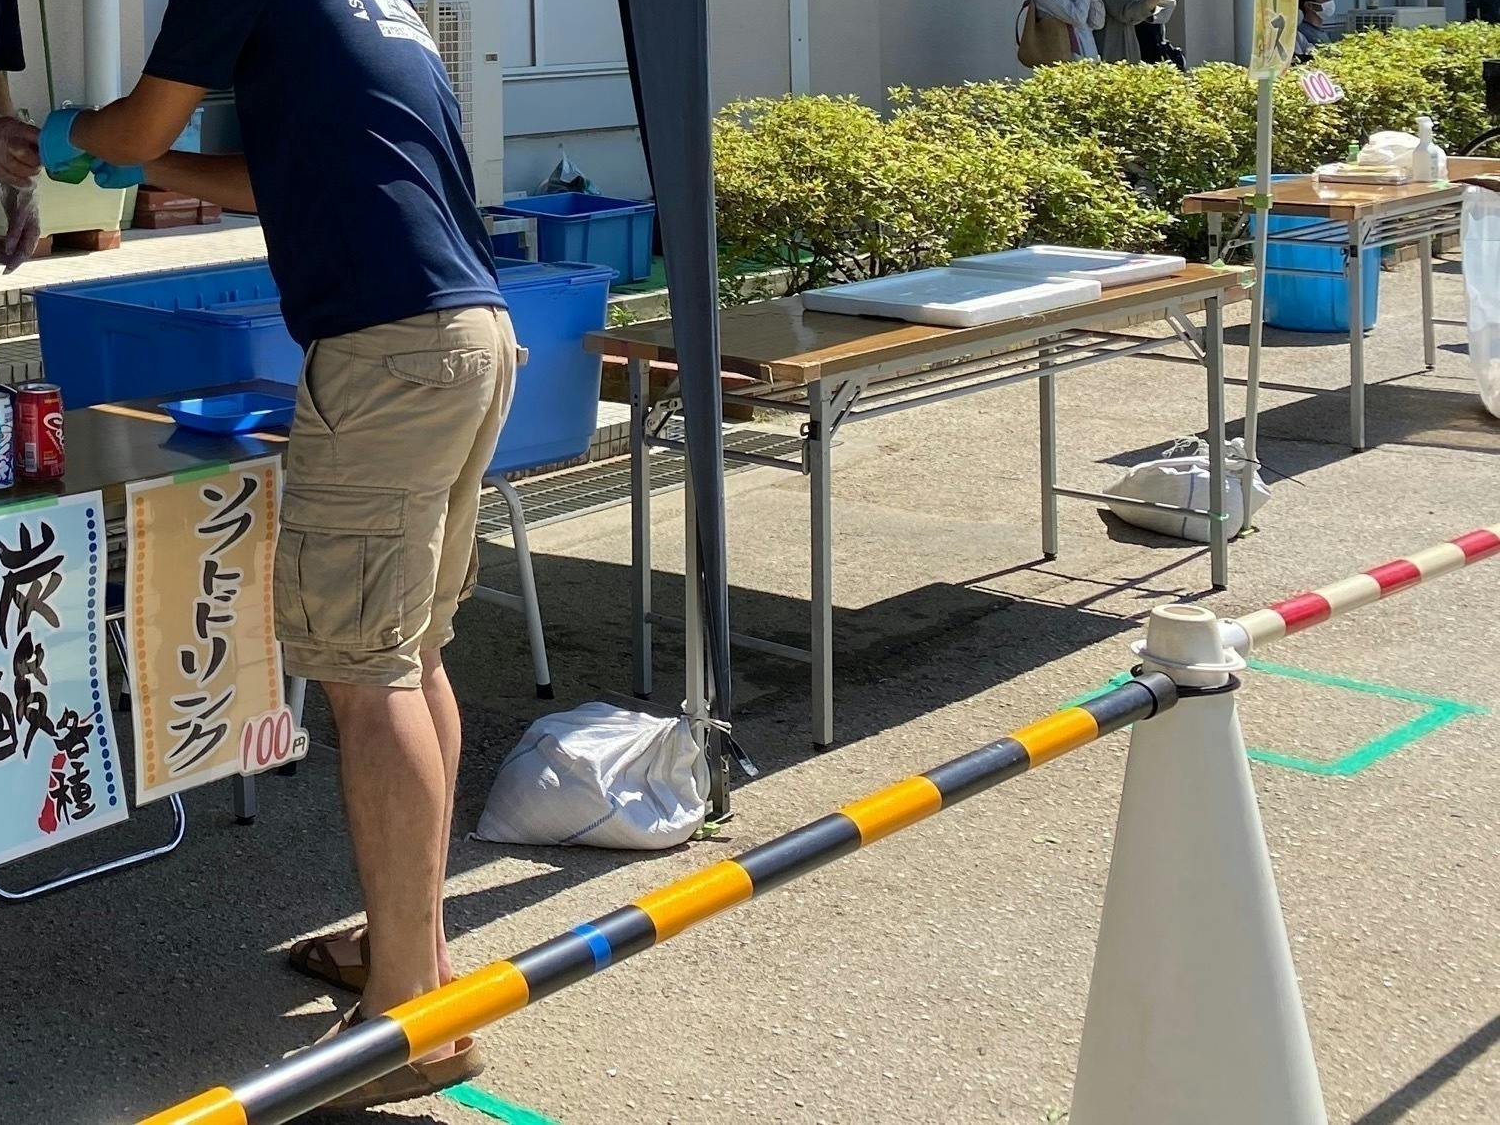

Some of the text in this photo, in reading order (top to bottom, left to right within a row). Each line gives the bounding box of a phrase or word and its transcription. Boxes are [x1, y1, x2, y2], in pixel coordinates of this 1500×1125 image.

[168, 477, 259, 773] ソフトドリンク
[49, 706, 97, 826] 各種
[243, 710, 306, 769] 100円
